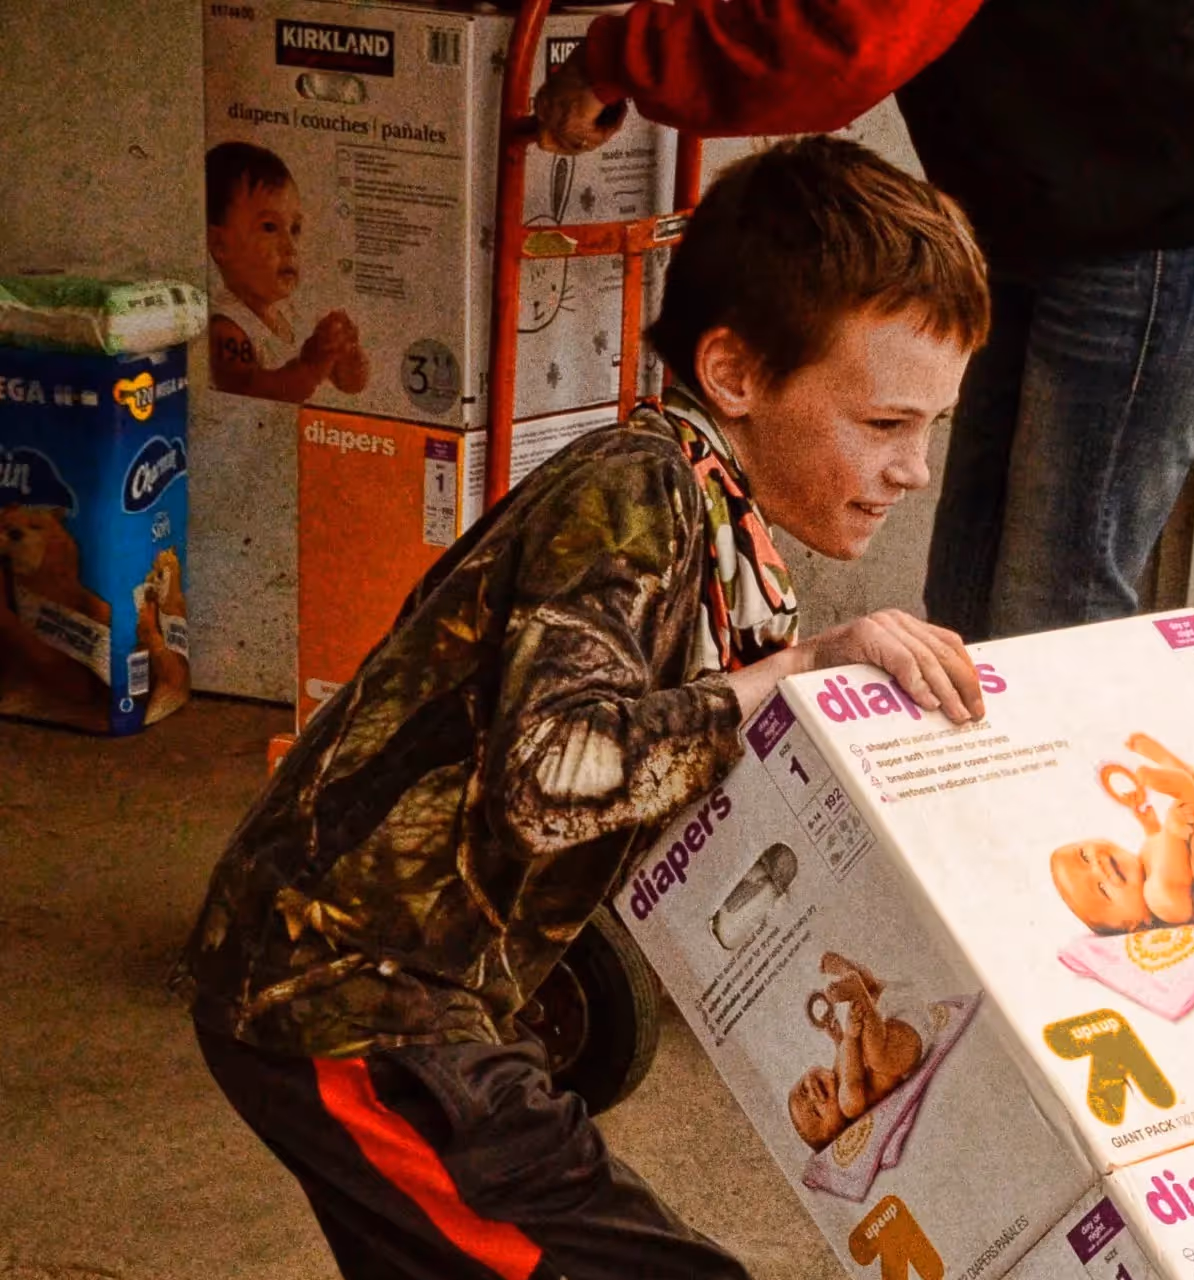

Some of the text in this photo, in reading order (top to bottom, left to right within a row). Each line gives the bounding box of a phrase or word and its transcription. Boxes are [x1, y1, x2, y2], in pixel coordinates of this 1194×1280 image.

[283, 26, 390, 57] KIRKLAND
[228, 103, 447, 144] diapers couches pañales
[0, 375, 46, 406] EGA
[408, 355, 429, 395] 3
[304, 420, 395, 457] diapers
[434, 472, 445, 493] 1
[789, 755, 810, 785] 1
[824, 787, 843, 810] 192
[630, 785, 733, 920] diapers
[1110, 1119, 1176, 1148] GIANT PACK
